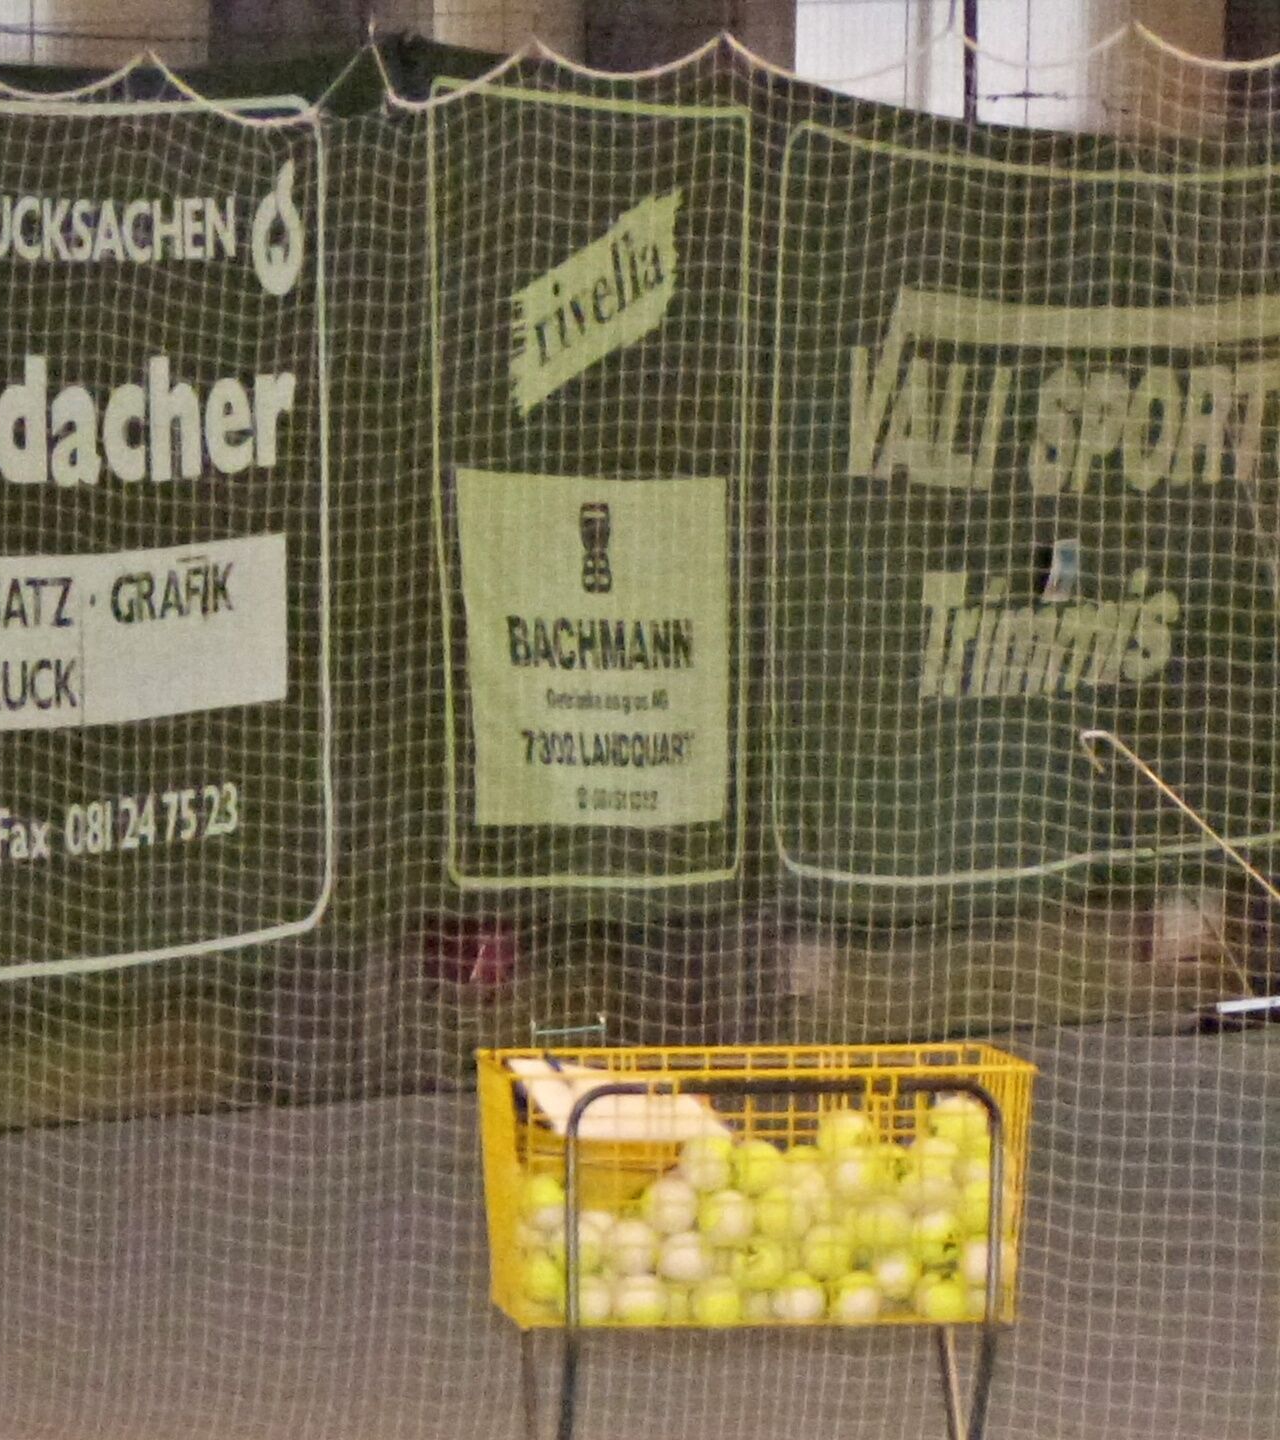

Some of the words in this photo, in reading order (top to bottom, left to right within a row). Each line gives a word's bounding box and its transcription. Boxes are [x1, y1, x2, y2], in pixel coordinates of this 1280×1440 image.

[535, 230, 665, 368] rivella
[110, 558, 234, 623] GRAFIK
[506, 615, 695, 670] BACHMANN
